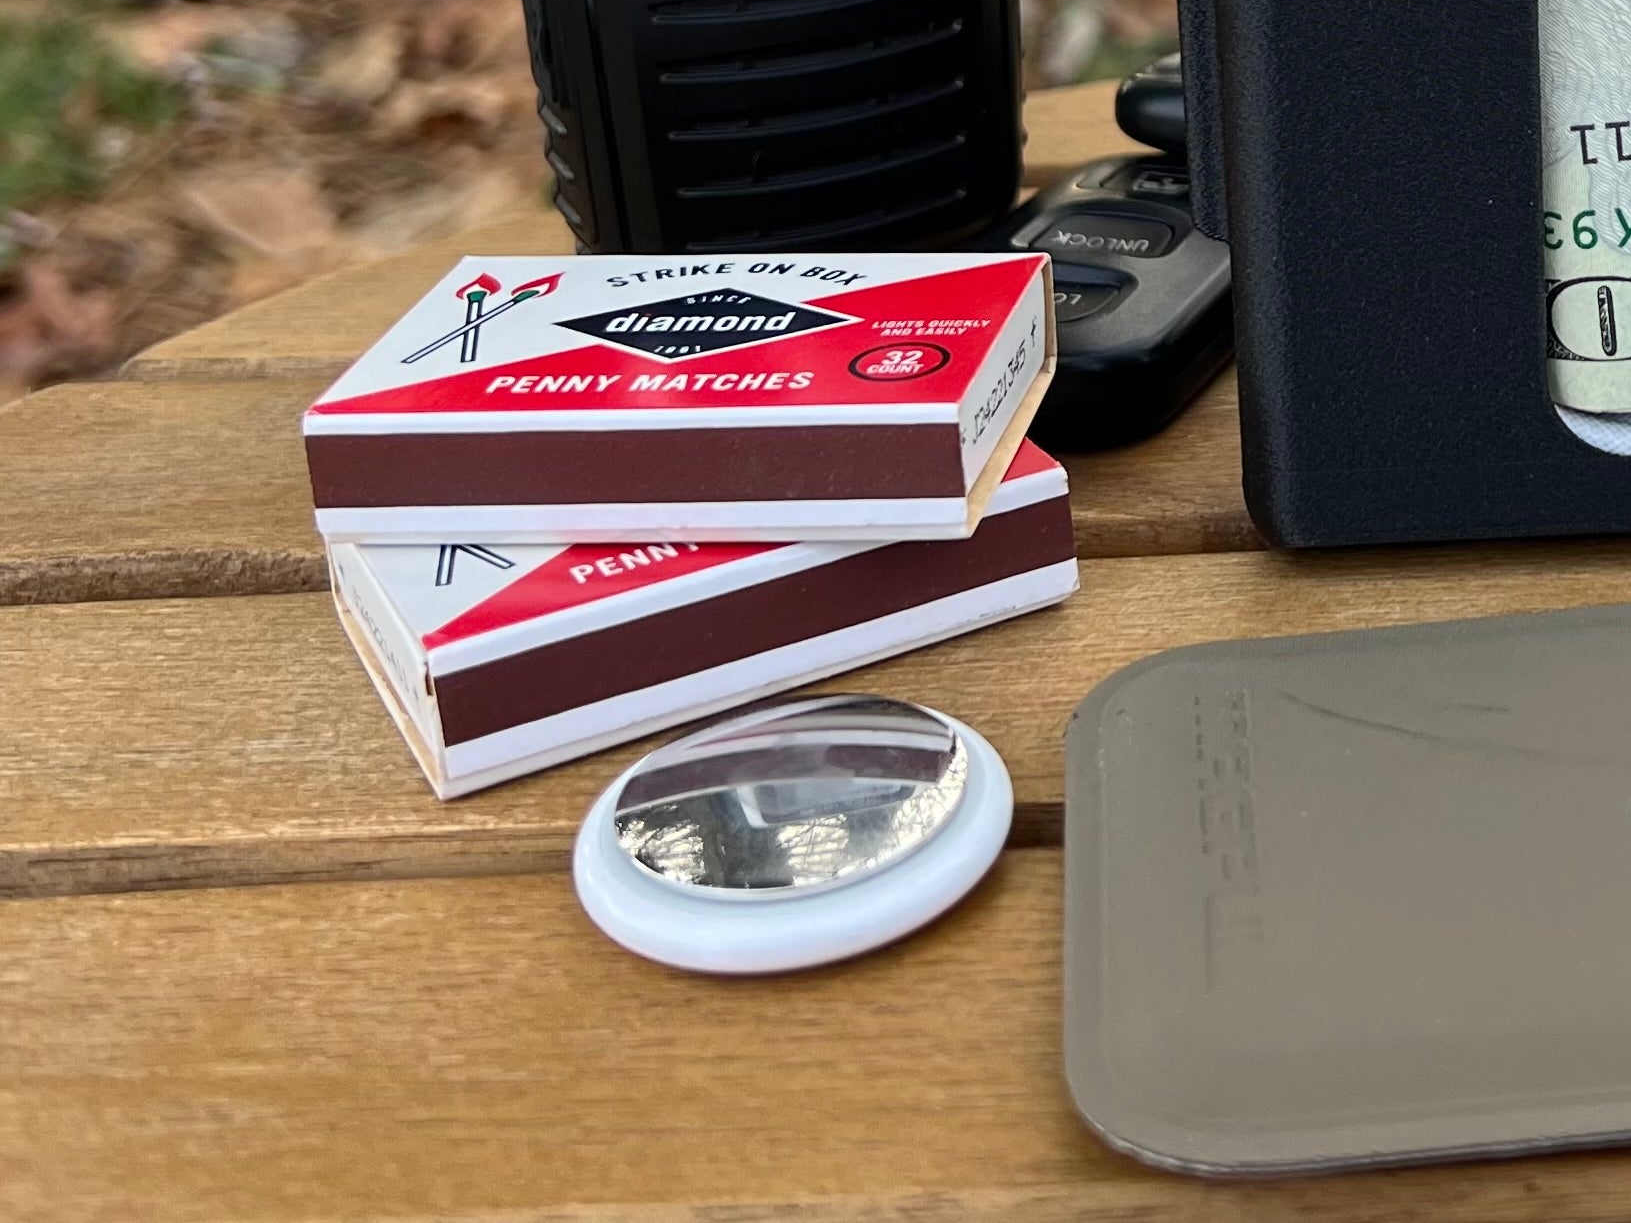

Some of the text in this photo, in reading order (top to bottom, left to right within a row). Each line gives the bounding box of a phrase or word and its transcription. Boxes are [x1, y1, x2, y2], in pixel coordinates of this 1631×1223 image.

[1051, 230, 1149, 252] UNLOCK
[606, 262, 868, 287] STRIKE ON BOX
[685, 294, 752, 305] SINCE
[605, 311, 797, 333] diamond
[871, 319, 991, 330] LIGHTS QUICKLY
[880, 327, 967, 337] AND EASILY
[881, 350, 924, 366] 32
[866, 363, 926, 375] COUNT
[485, 371, 815, 395] PENNY MATCHES
